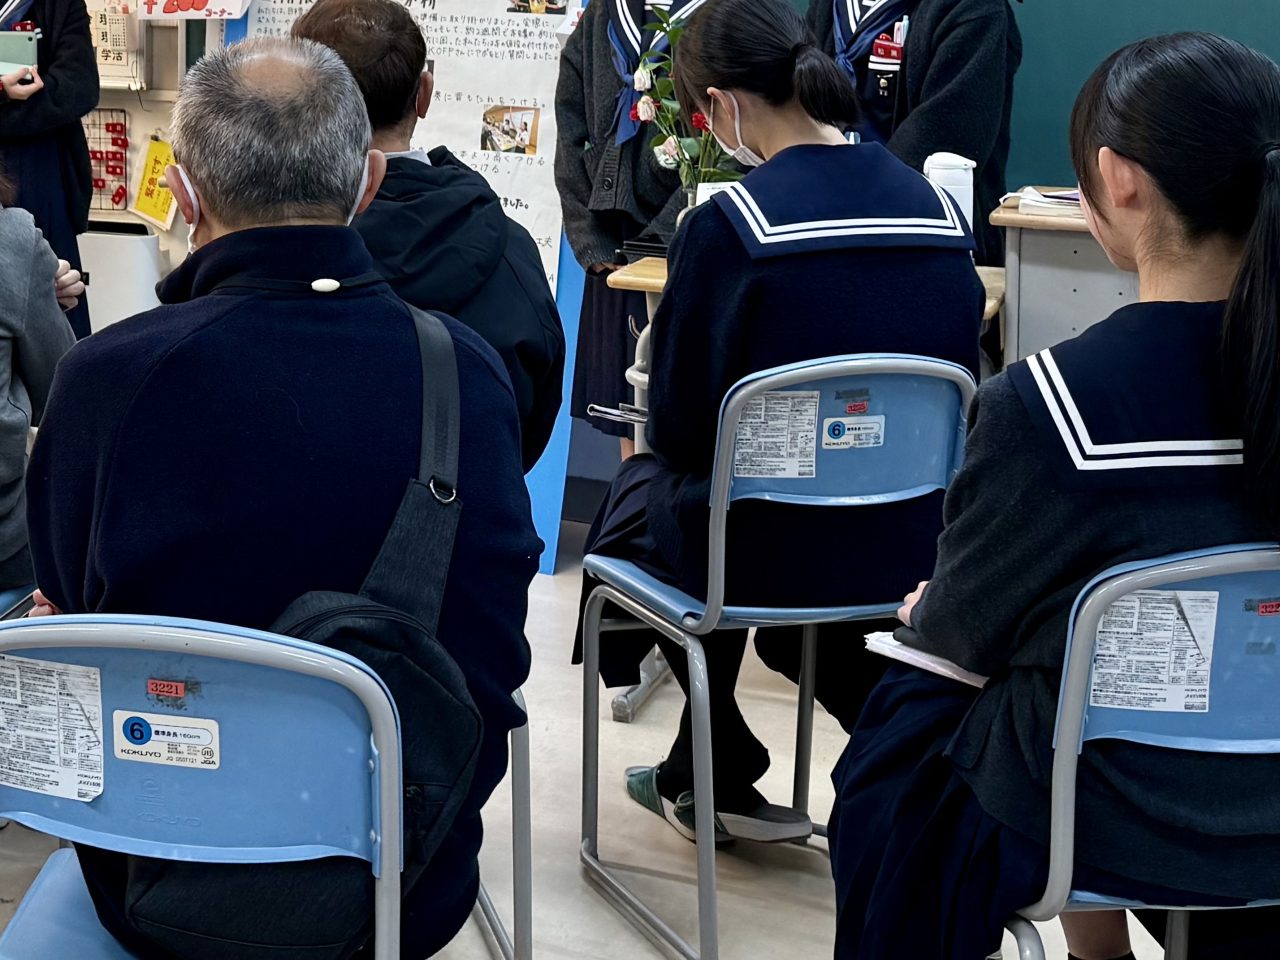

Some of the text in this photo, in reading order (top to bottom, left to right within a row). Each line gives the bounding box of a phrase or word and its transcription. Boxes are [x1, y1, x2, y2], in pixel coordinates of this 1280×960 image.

[101, 48, 123, 62] 学活
[144, 155, 162, 199] 緊急です
[498, 196, 530, 210] ました。
[831, 423, 841, 437] 6
[151, 681, 181, 696] 3221
[130, 722, 145, 741] 6
[120, 748, 162, 758] KOKUYO
